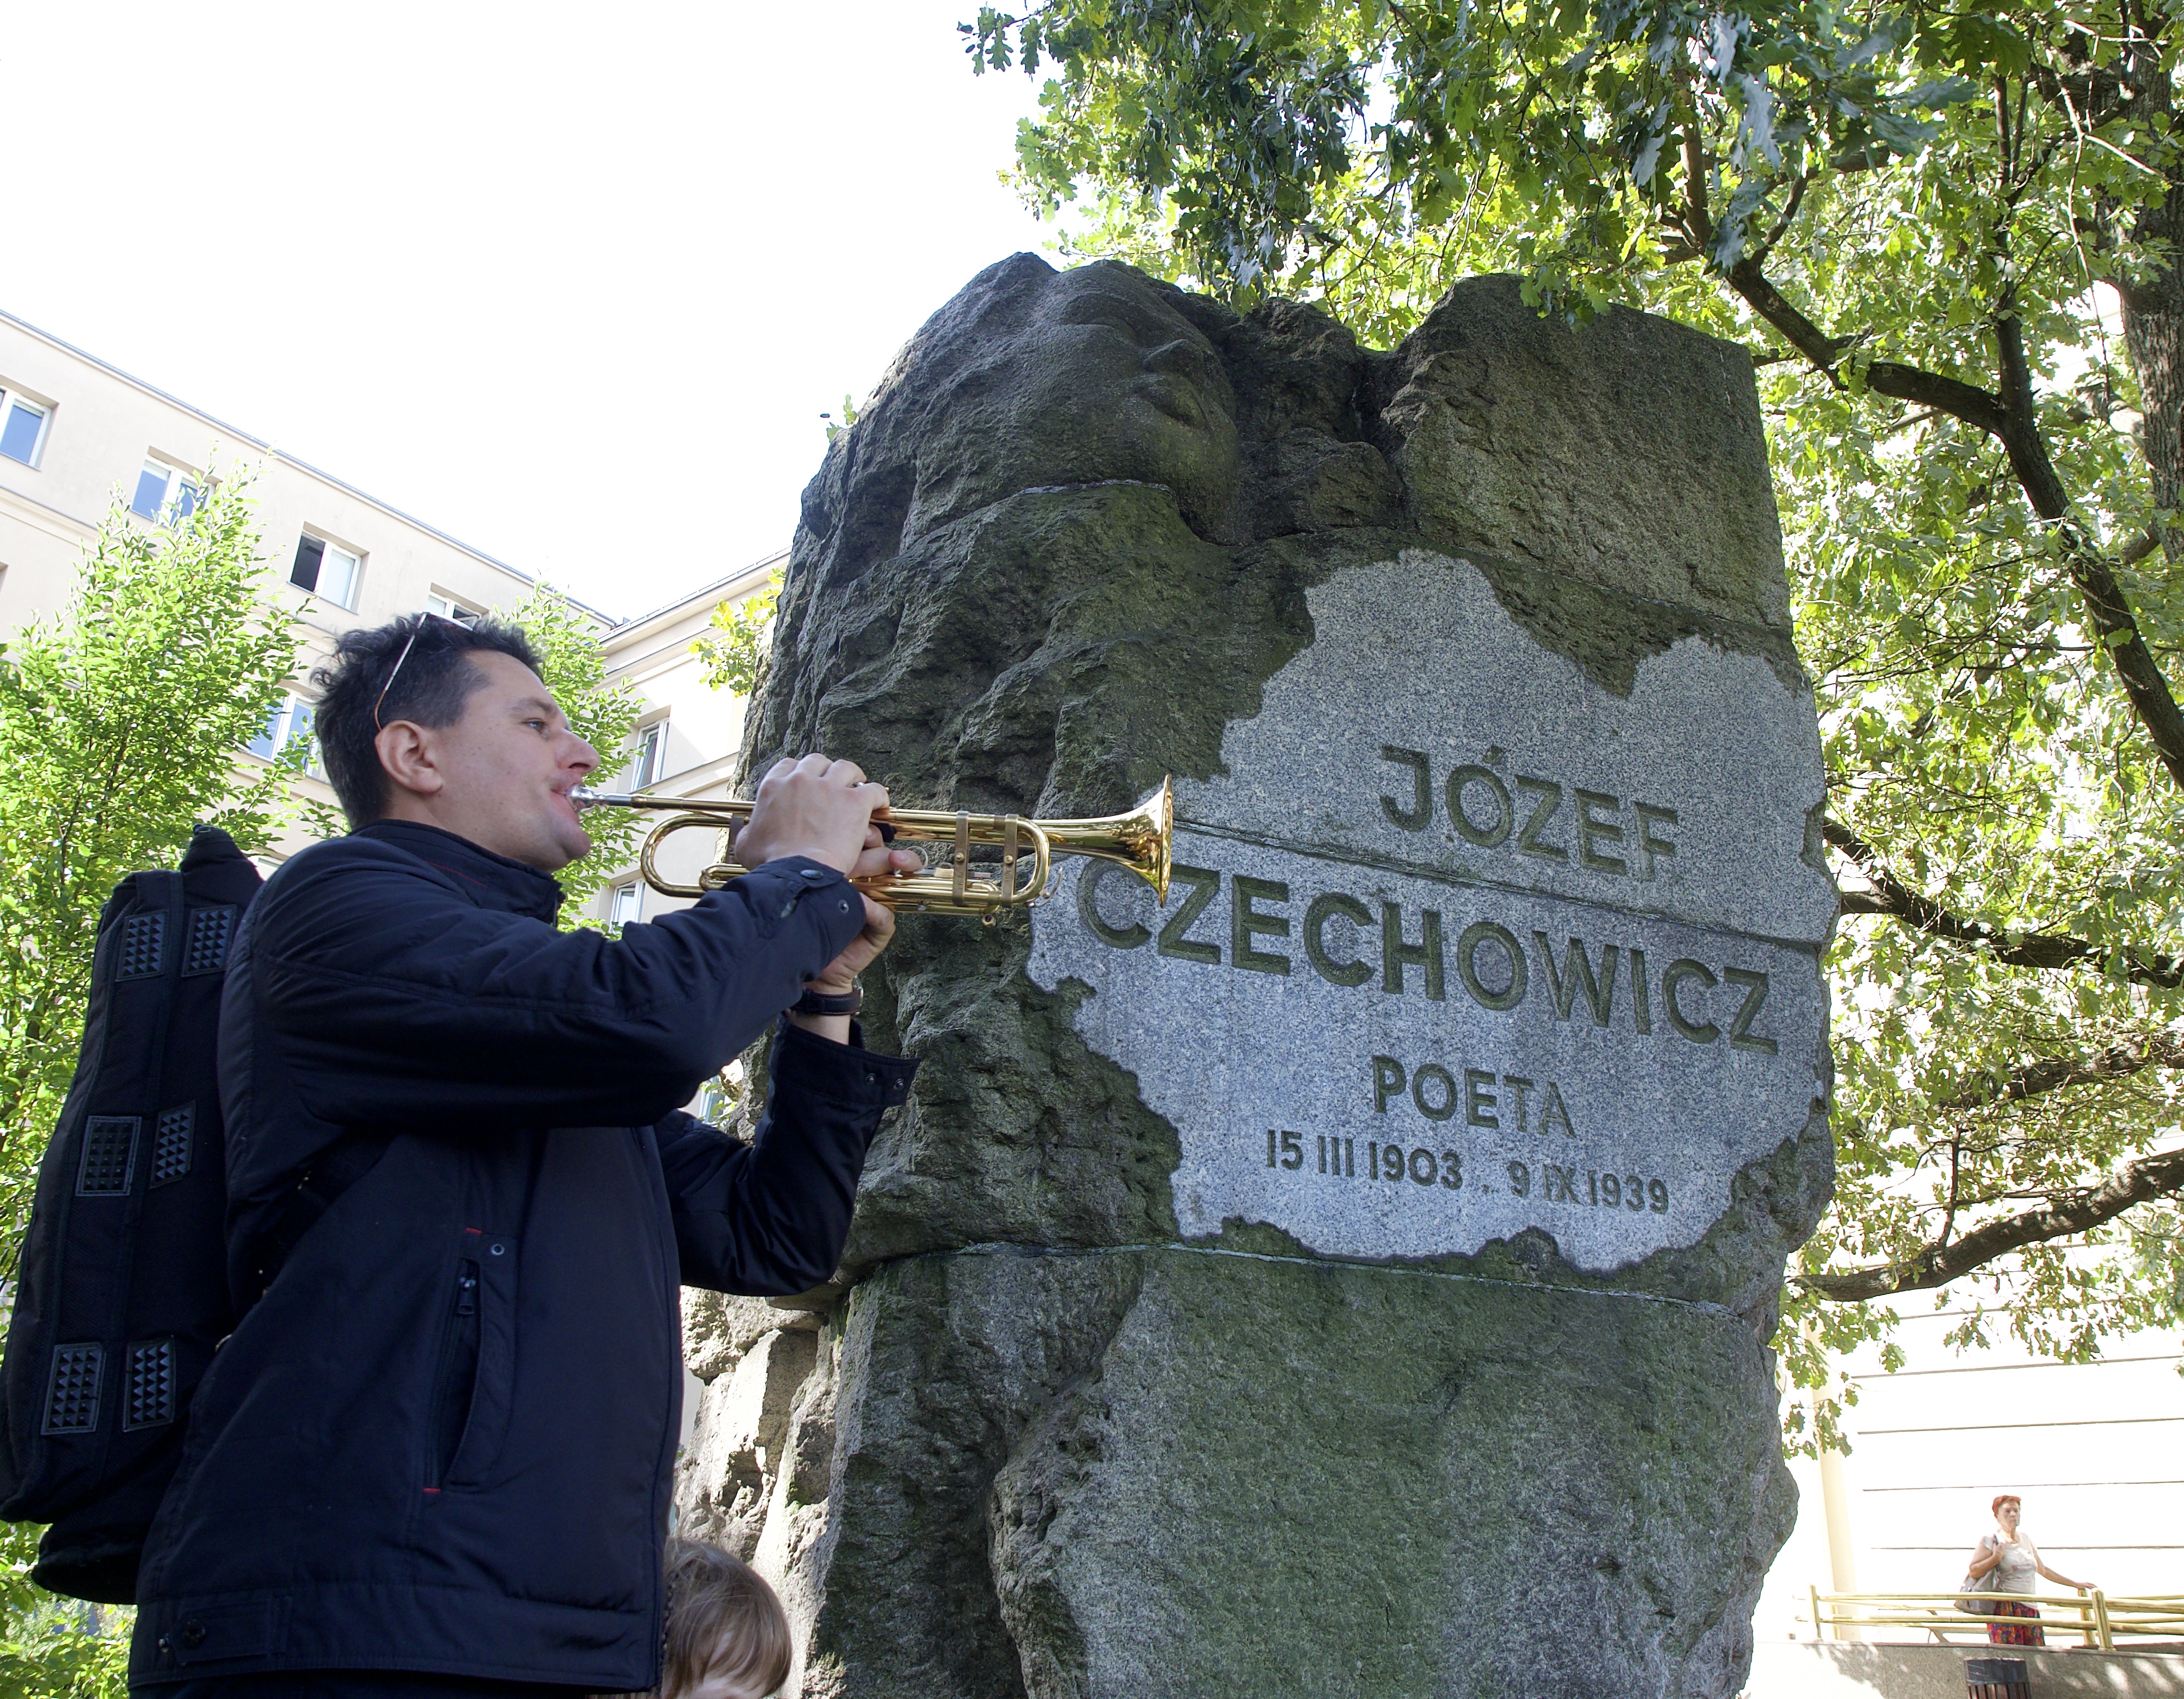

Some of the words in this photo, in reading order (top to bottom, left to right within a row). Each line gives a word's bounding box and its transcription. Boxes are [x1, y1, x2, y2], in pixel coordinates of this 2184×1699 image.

[1380, 745, 1678, 881] JÓZEF
[1076, 858, 1778, 1055] CZECHOWICZ
[1373, 1054, 1576, 1139] POETA
[1267, 1129, 1303, 1170] 15
[1317, 1135, 1354, 1177] III
[1369, 1141, 1462, 1190] 1903
[1507, 1160, 1530, 1197] 9
[1543, 1164, 1580, 1205] IX
[1588, 1170, 1669, 1215] 1939
